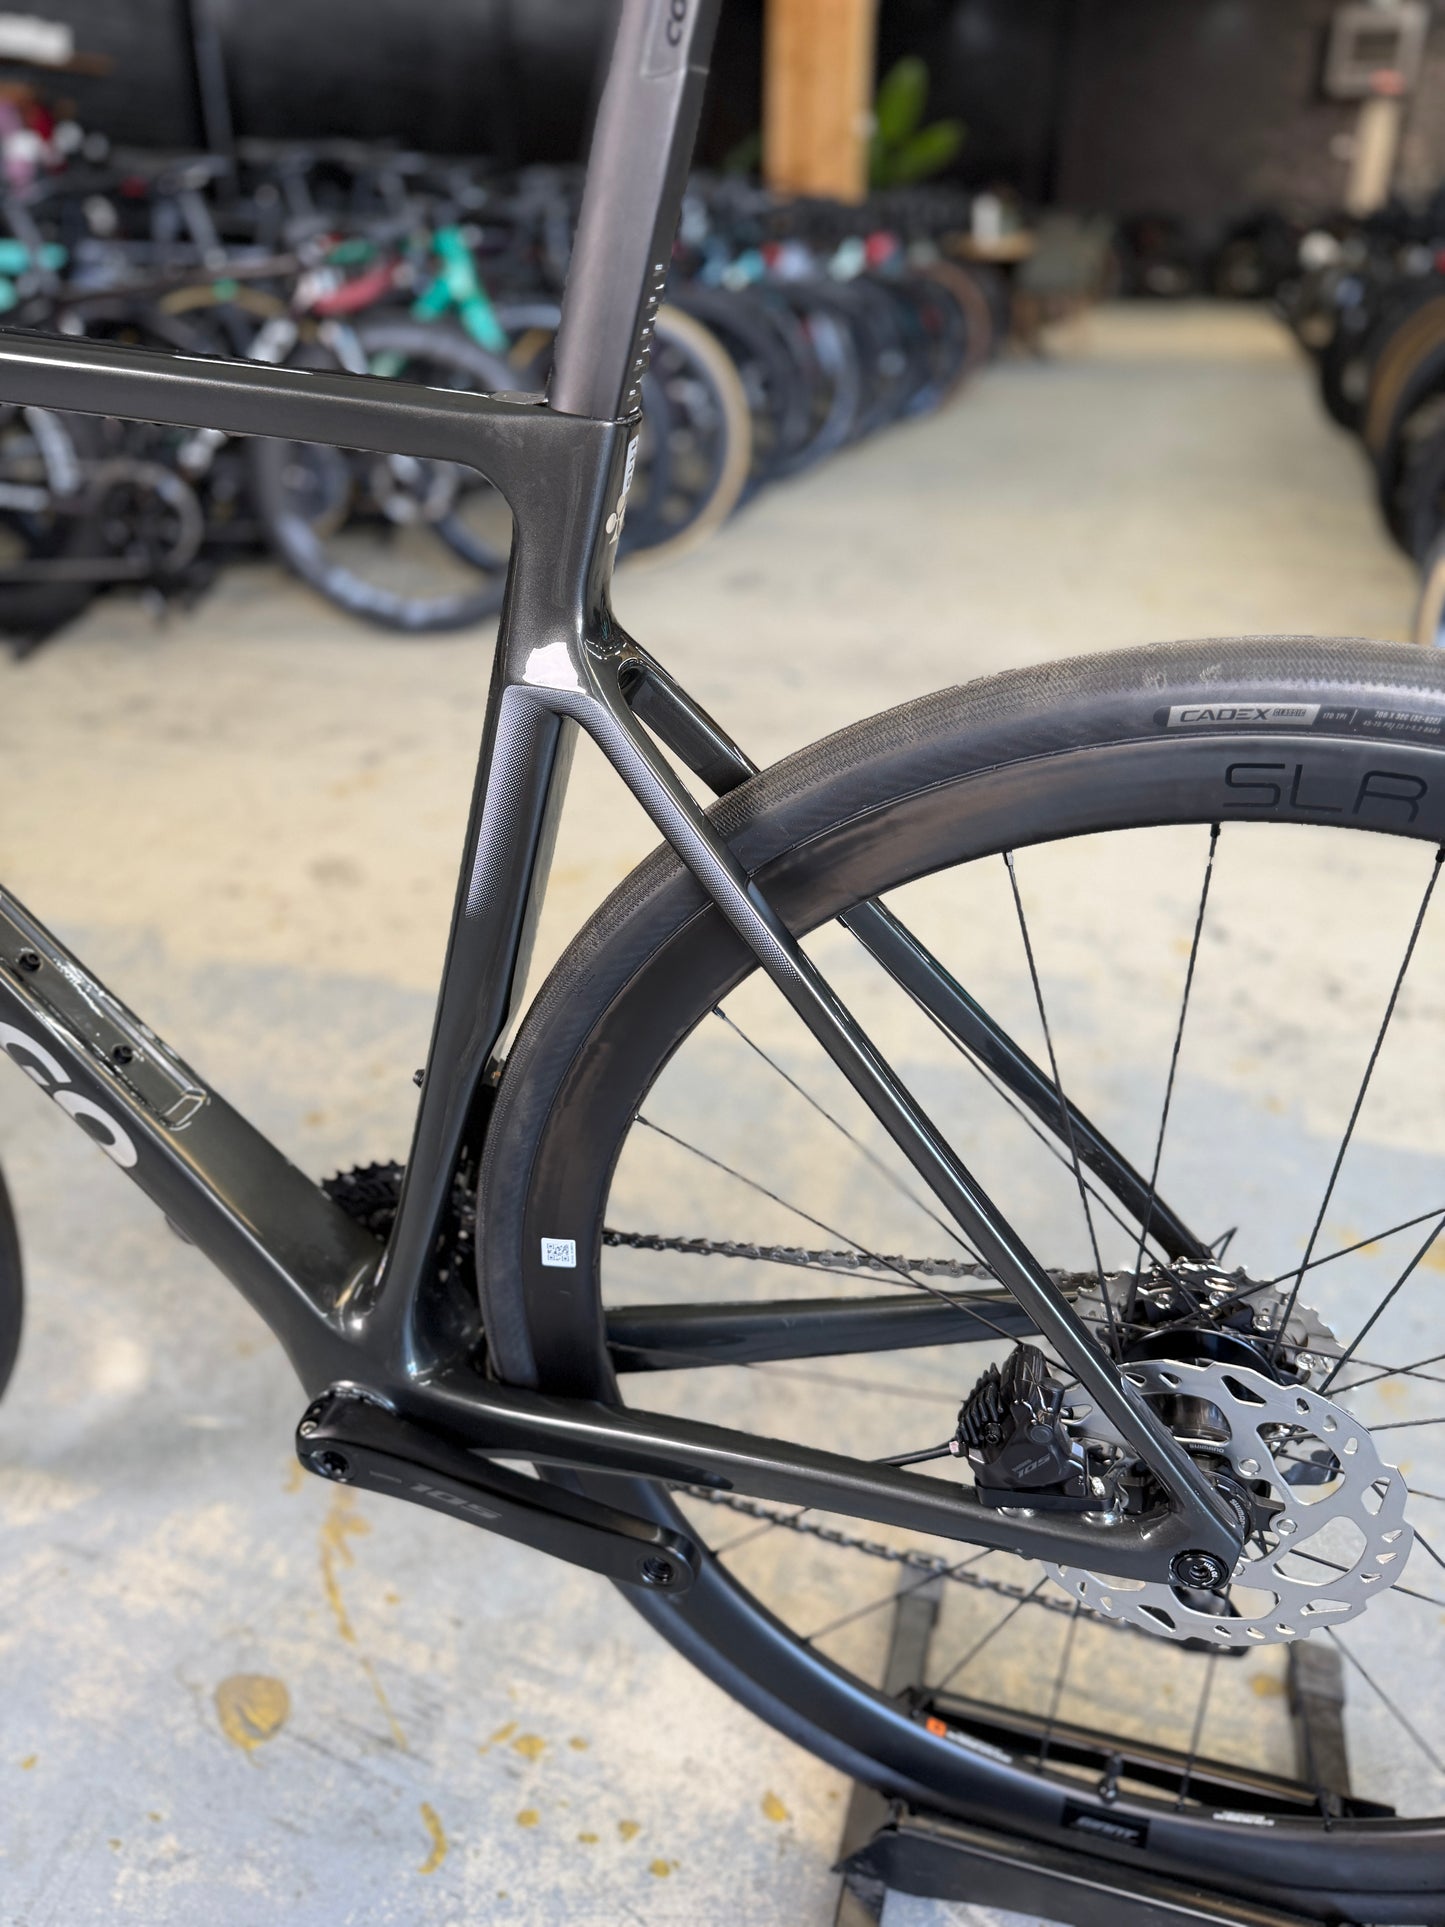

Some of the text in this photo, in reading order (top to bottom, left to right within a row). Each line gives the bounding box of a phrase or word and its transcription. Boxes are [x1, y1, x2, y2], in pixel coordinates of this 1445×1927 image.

[1180, 708, 1271, 723] CADEX
[1222, 762, 1429, 824] SLR
[409, 1481, 503, 1520] 105
[1229, 1498, 1247, 1529] SHIMAN
